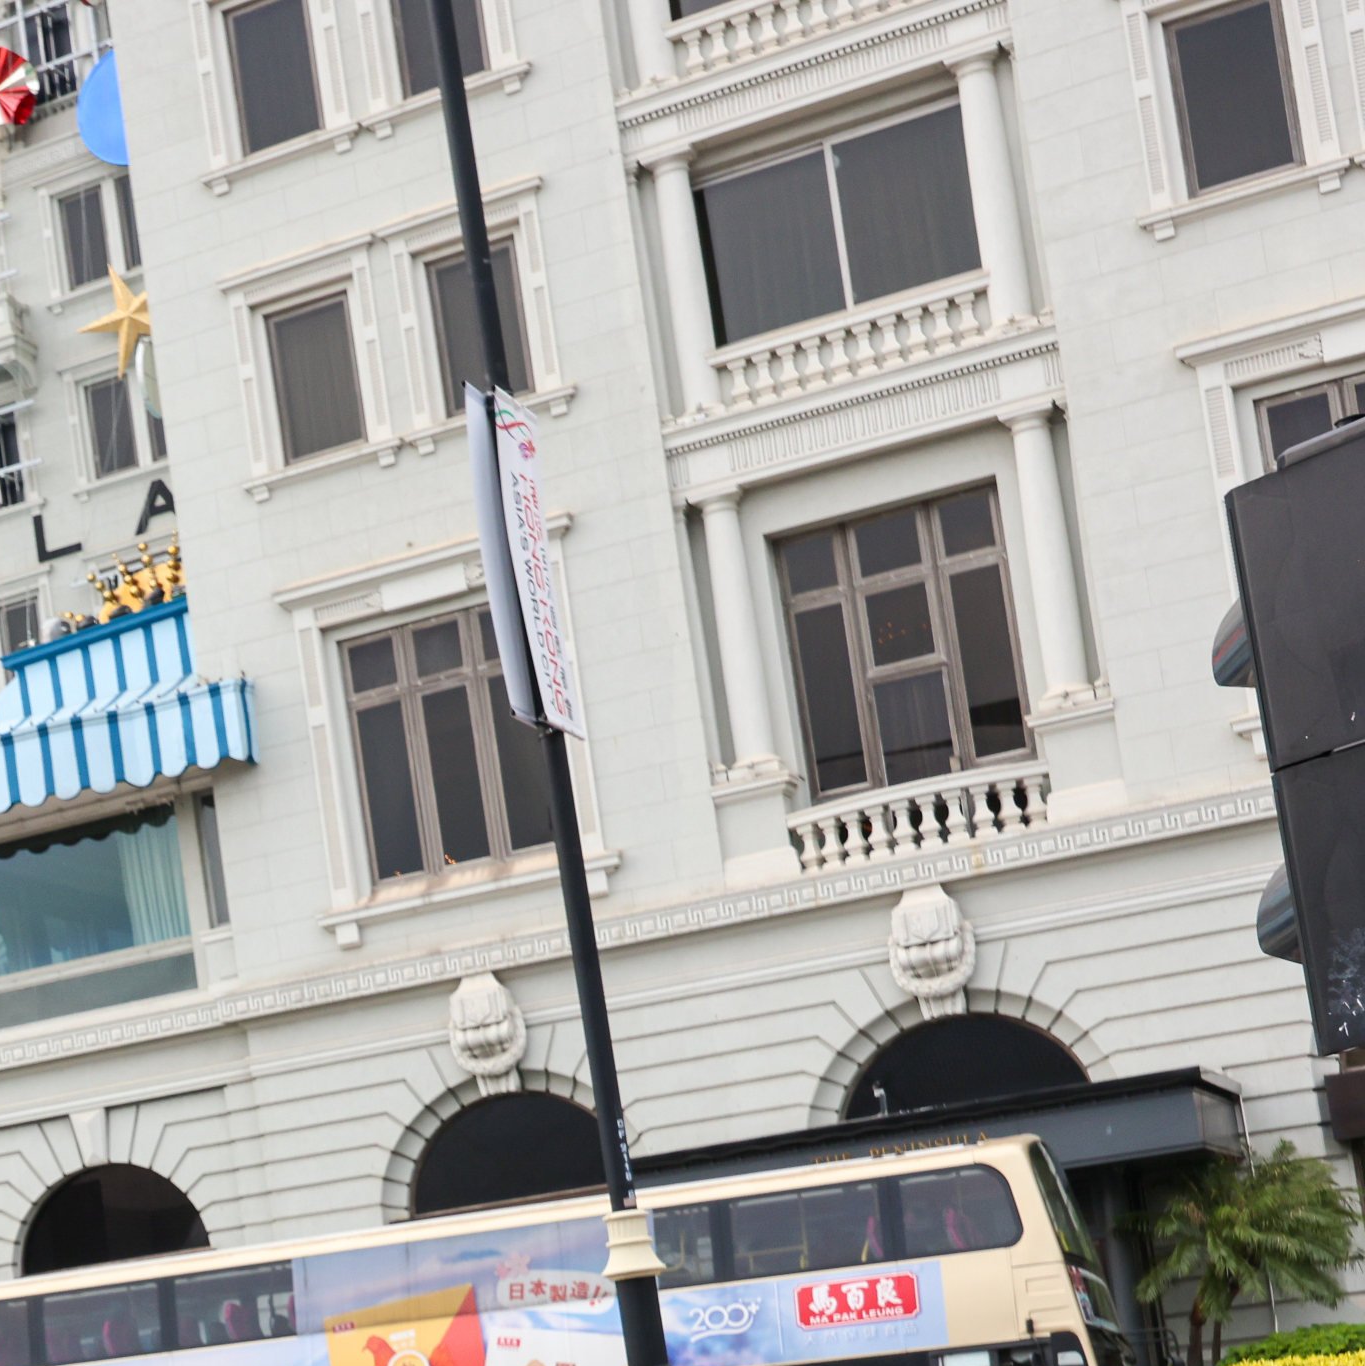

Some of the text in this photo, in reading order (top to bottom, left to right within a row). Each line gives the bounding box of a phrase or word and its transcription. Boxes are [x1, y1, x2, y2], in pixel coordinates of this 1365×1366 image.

[519, 473, 545, 591] HONG
[539, 598, 566, 716] KONG
[808, 1277, 903, 1314] 馬百良
[809, 1305, 904, 1325] MA PAK LEUNG
